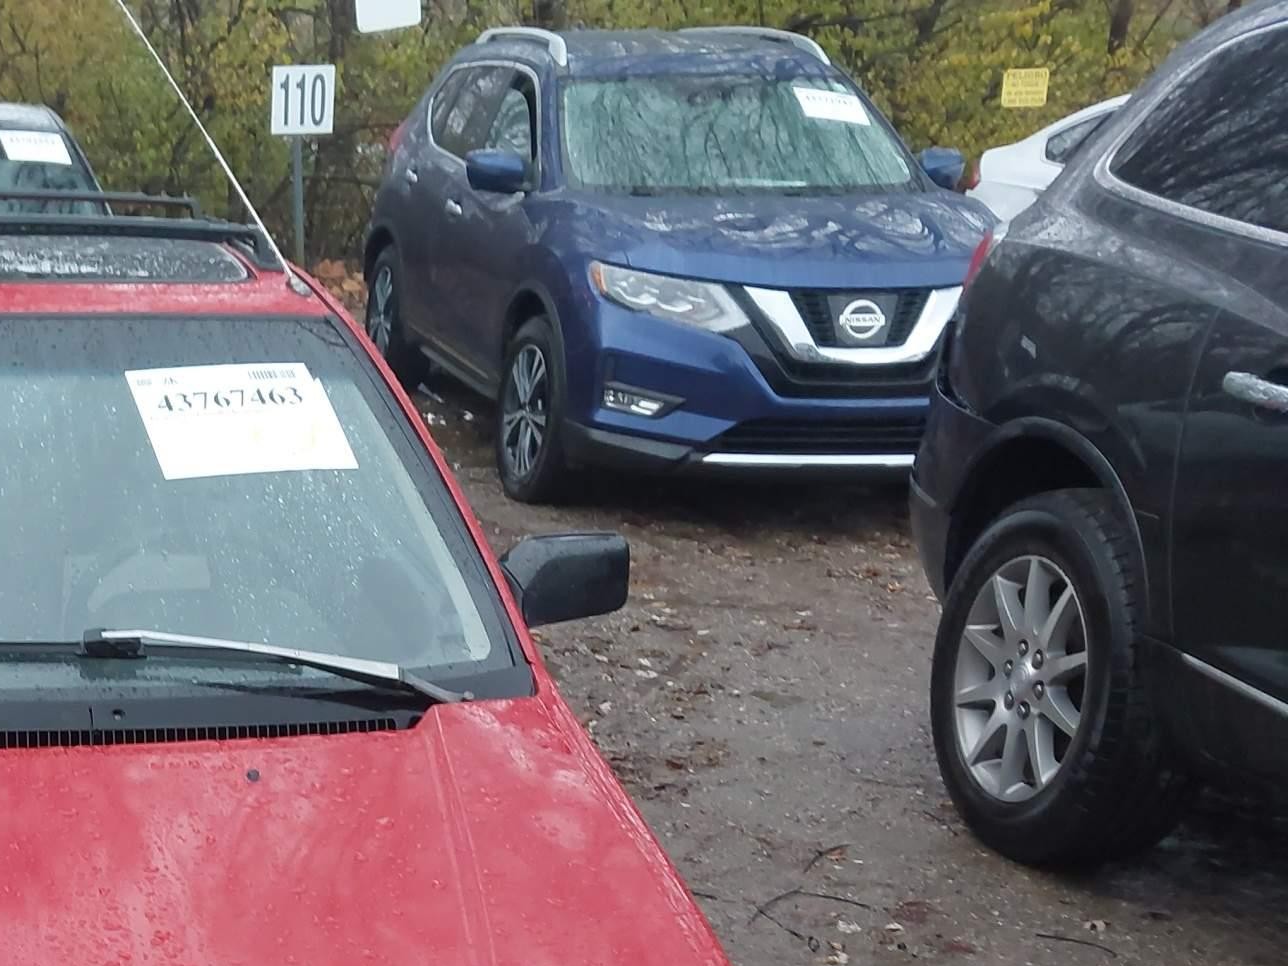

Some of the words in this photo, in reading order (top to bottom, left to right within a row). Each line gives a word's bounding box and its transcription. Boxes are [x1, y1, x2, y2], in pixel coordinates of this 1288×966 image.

[280, 73, 326, 126] 110
[845, 315, 881, 323] NISSAN
[157, 386, 304, 412] 43767463
